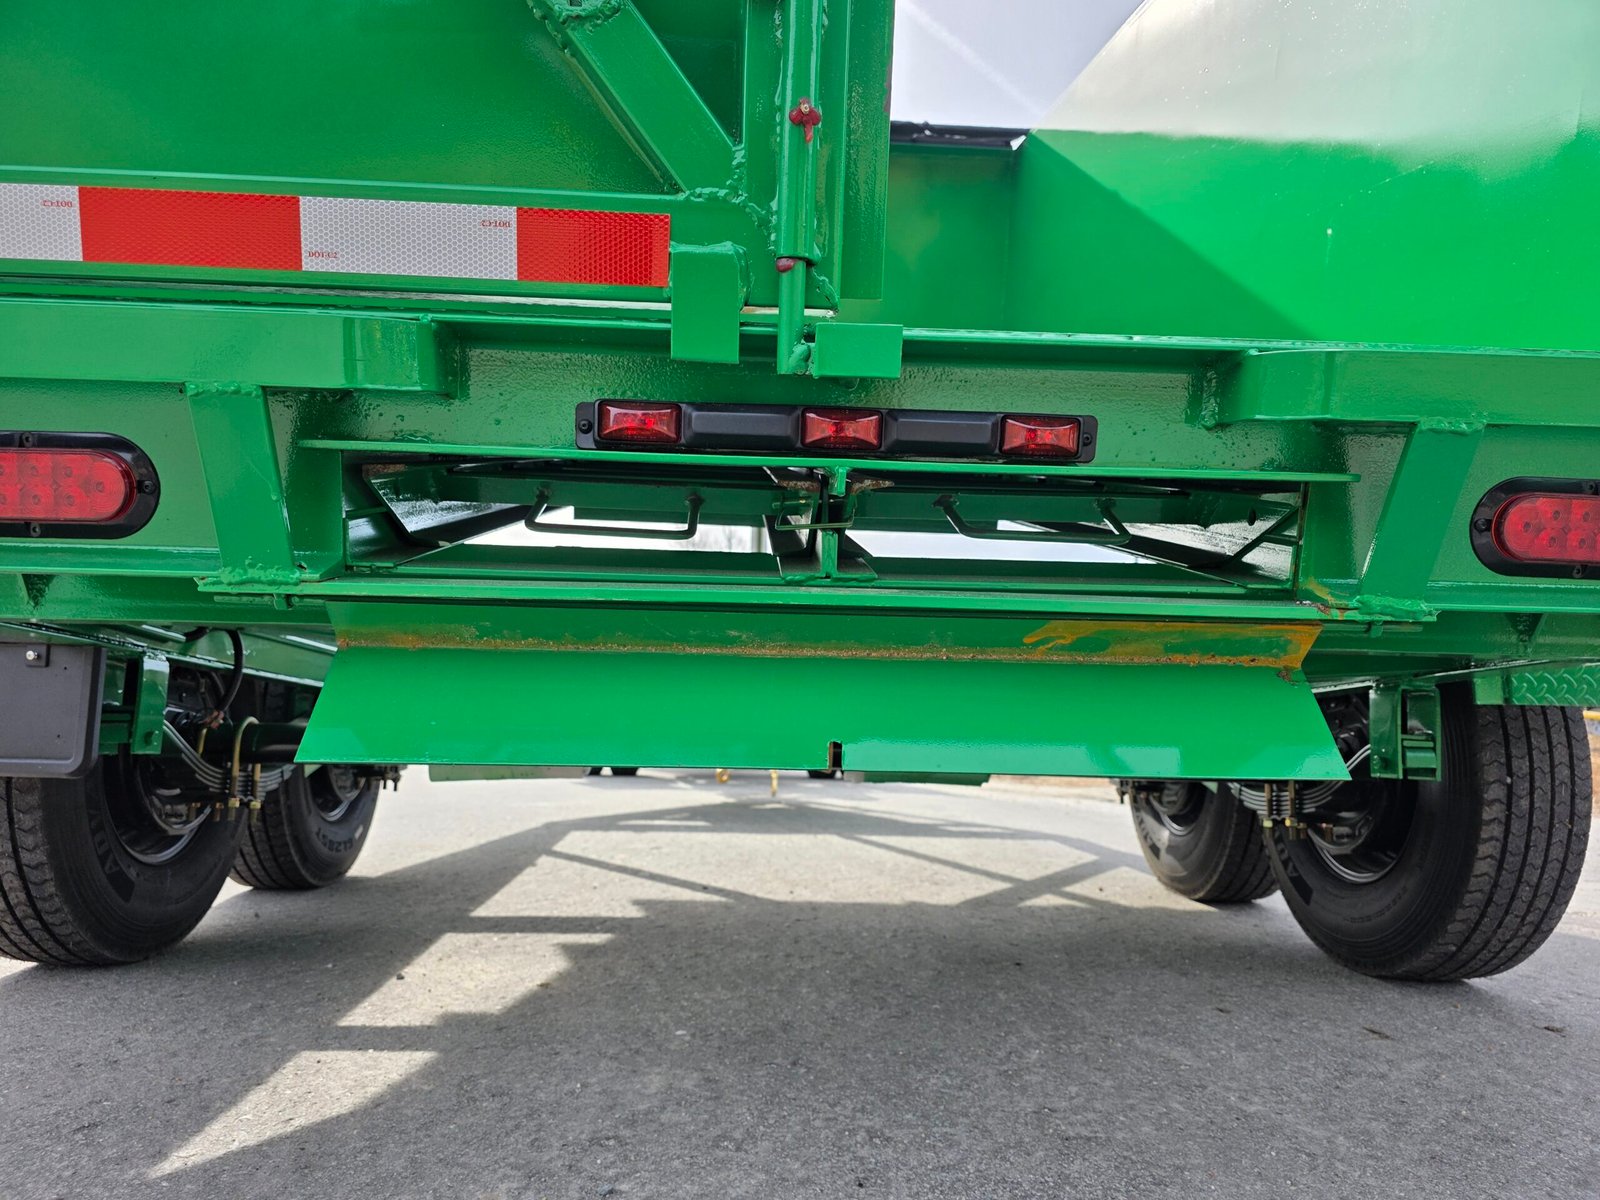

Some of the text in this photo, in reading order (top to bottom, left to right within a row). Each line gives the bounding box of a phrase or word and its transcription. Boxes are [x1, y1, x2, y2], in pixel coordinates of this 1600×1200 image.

[43, 200, 73, 208] DOT-C2
[481, 220, 511, 228] DOT-C2
[308, 251, 338, 259] DOT-C2
